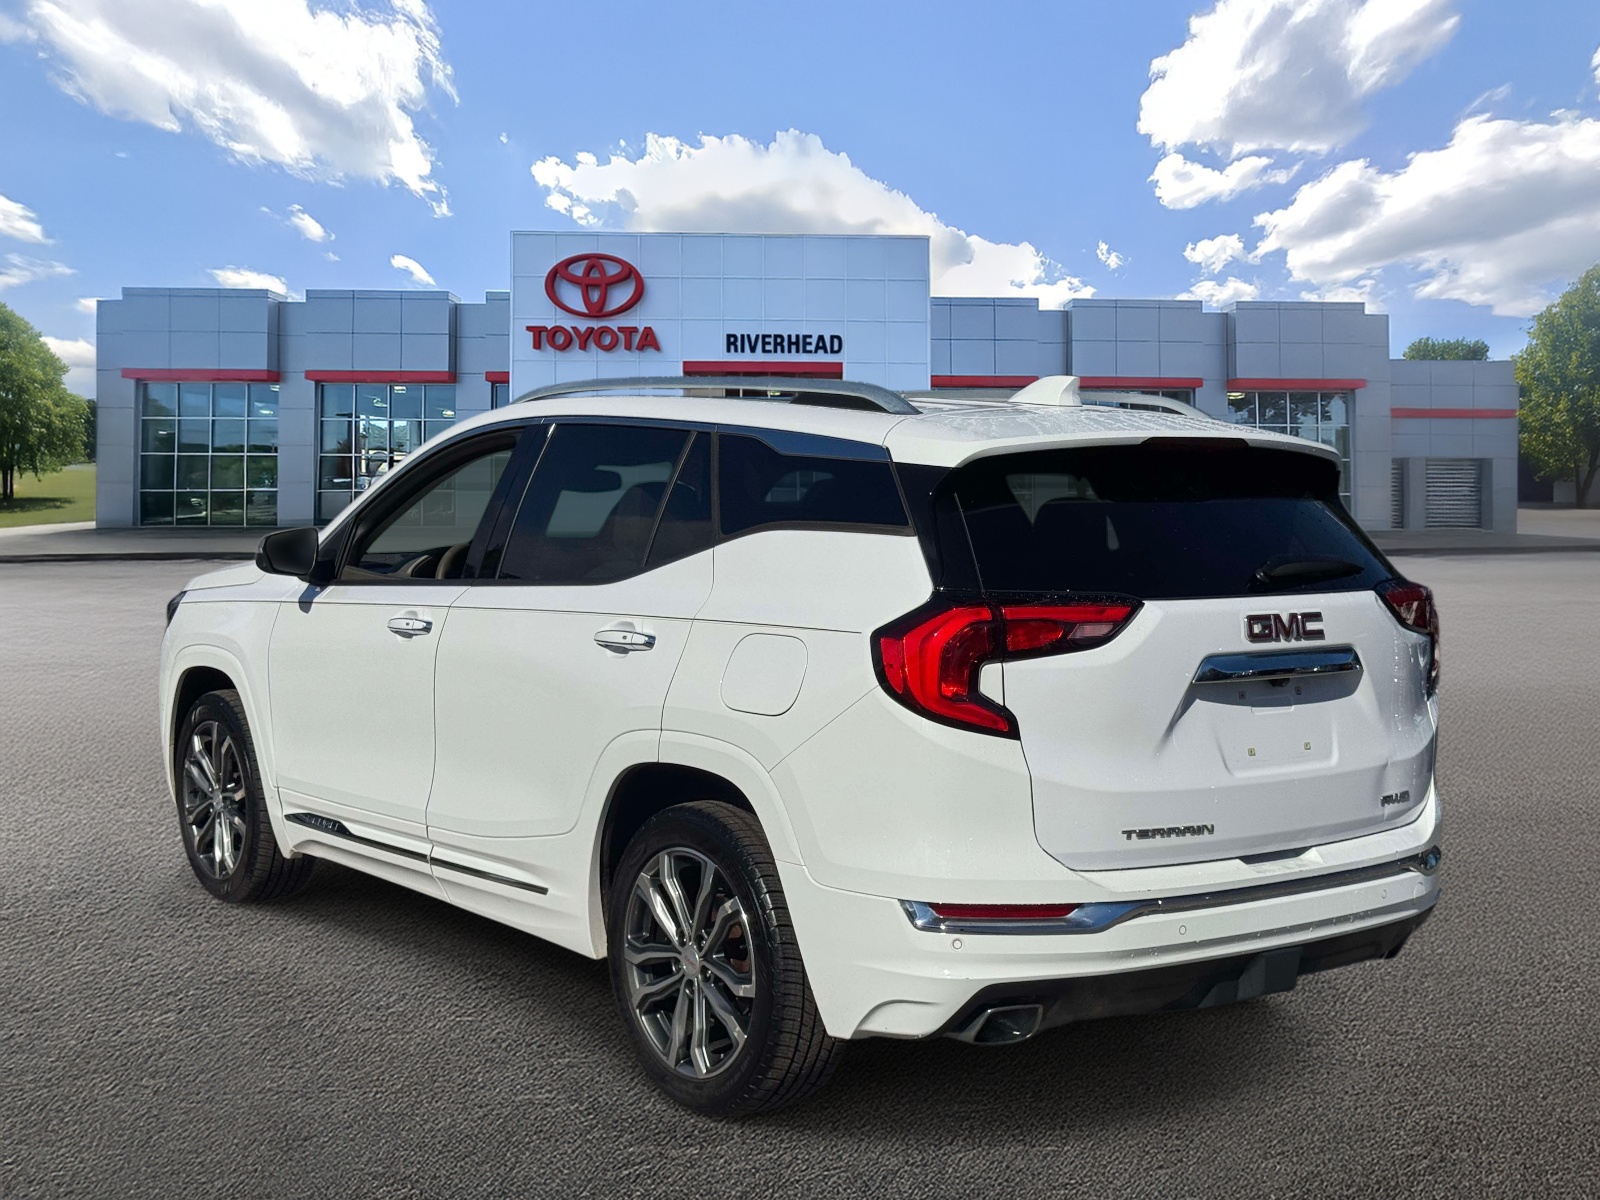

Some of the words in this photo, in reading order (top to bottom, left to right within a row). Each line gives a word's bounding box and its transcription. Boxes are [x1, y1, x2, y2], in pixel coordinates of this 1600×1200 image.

[526, 325, 661, 352] TOYOTA
[725, 334, 844, 355] RIVERHEAD
[1243, 611, 1326, 644] GMC
[1121, 824, 1214, 841] TERRAIN
